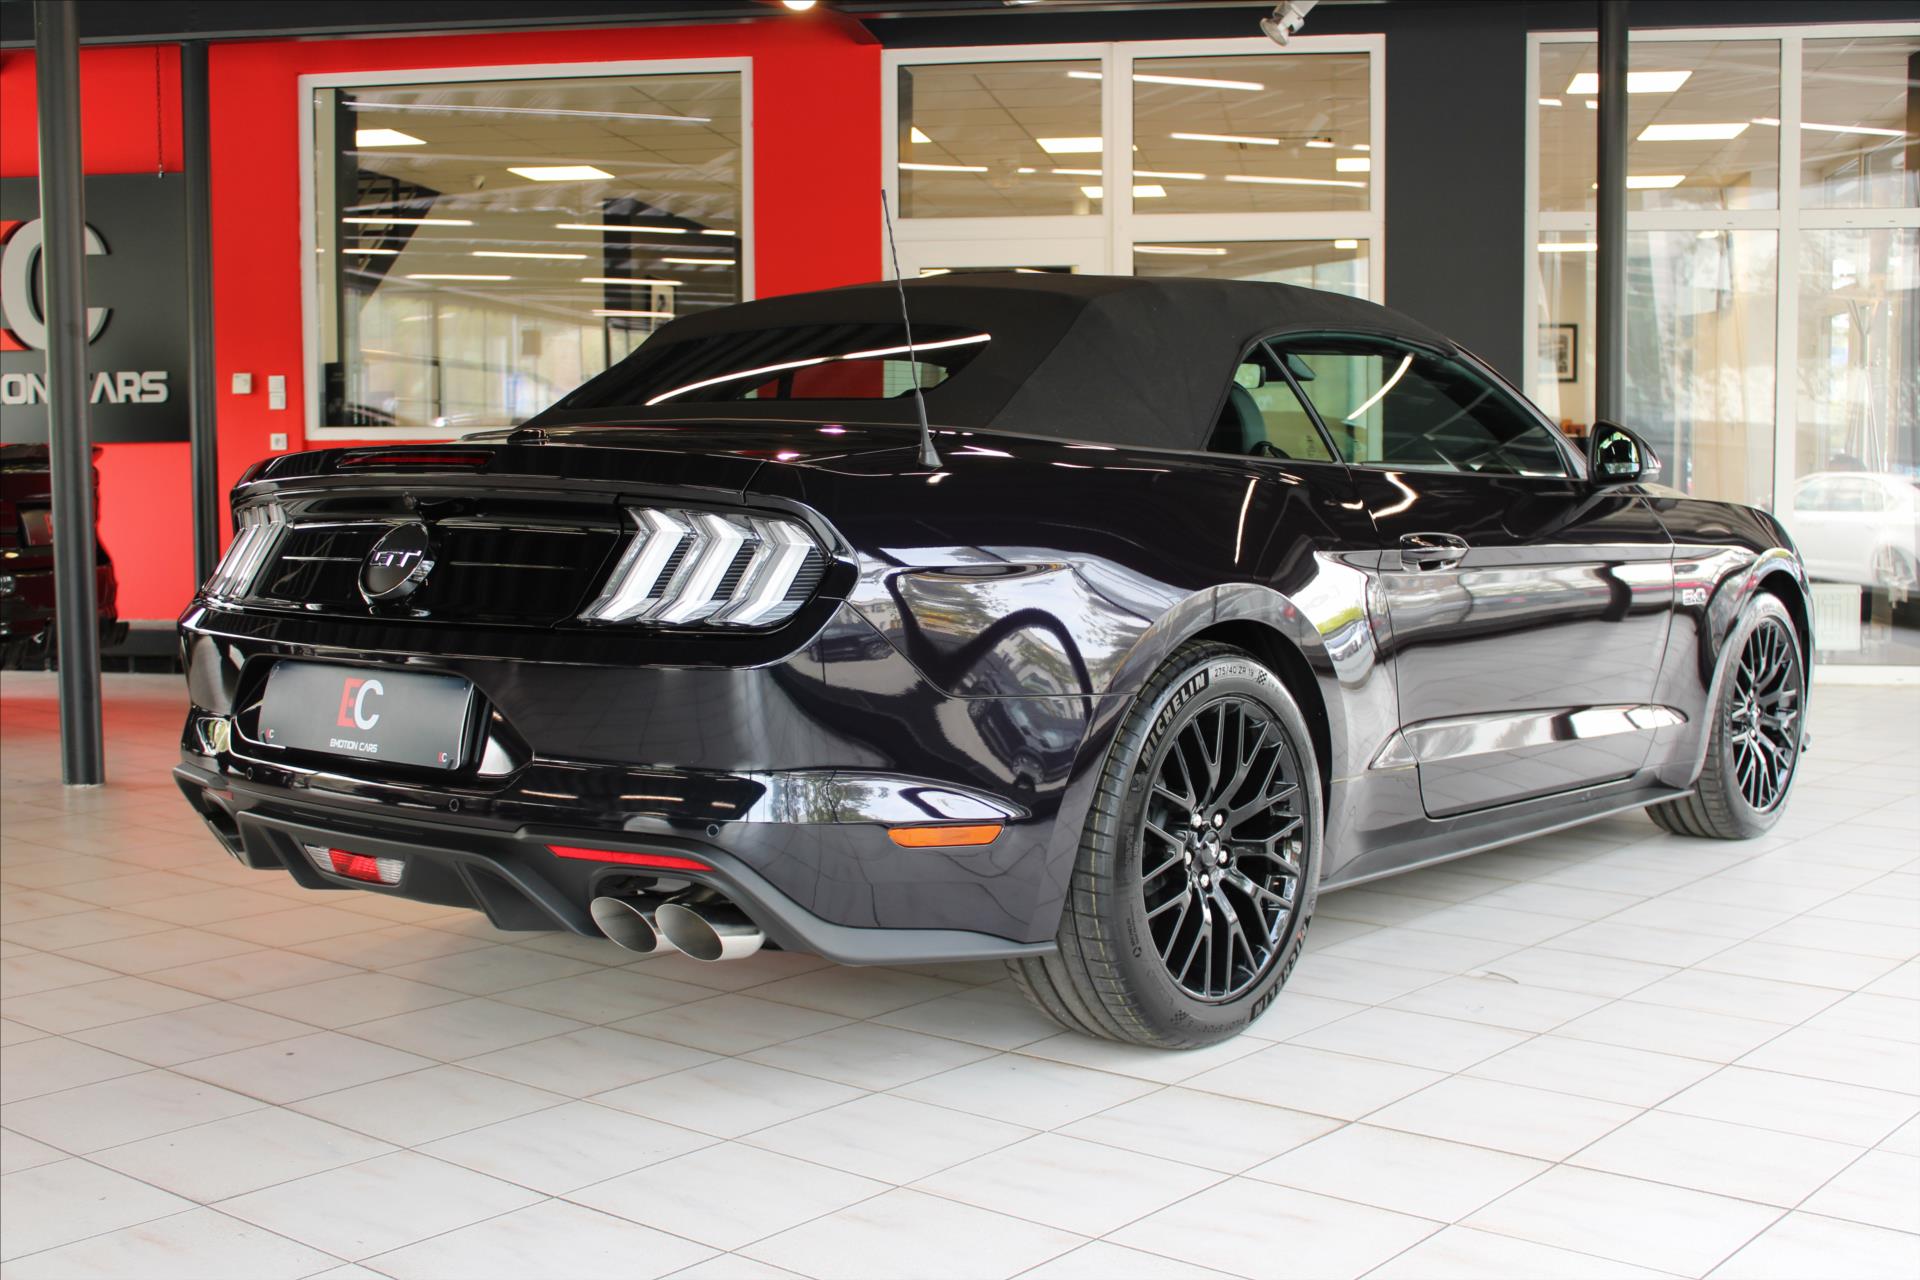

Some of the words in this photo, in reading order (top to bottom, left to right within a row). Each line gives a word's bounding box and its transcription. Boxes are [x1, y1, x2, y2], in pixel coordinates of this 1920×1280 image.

[90, 371, 168, 403] ARS
[369, 550, 423, 568] GT
[336, 677, 384, 730] EC
[1141, 672, 1206, 767] MICHELIN
[329, 738, 359, 750] EMOTION
[358, 742, 379, 753] CARS
